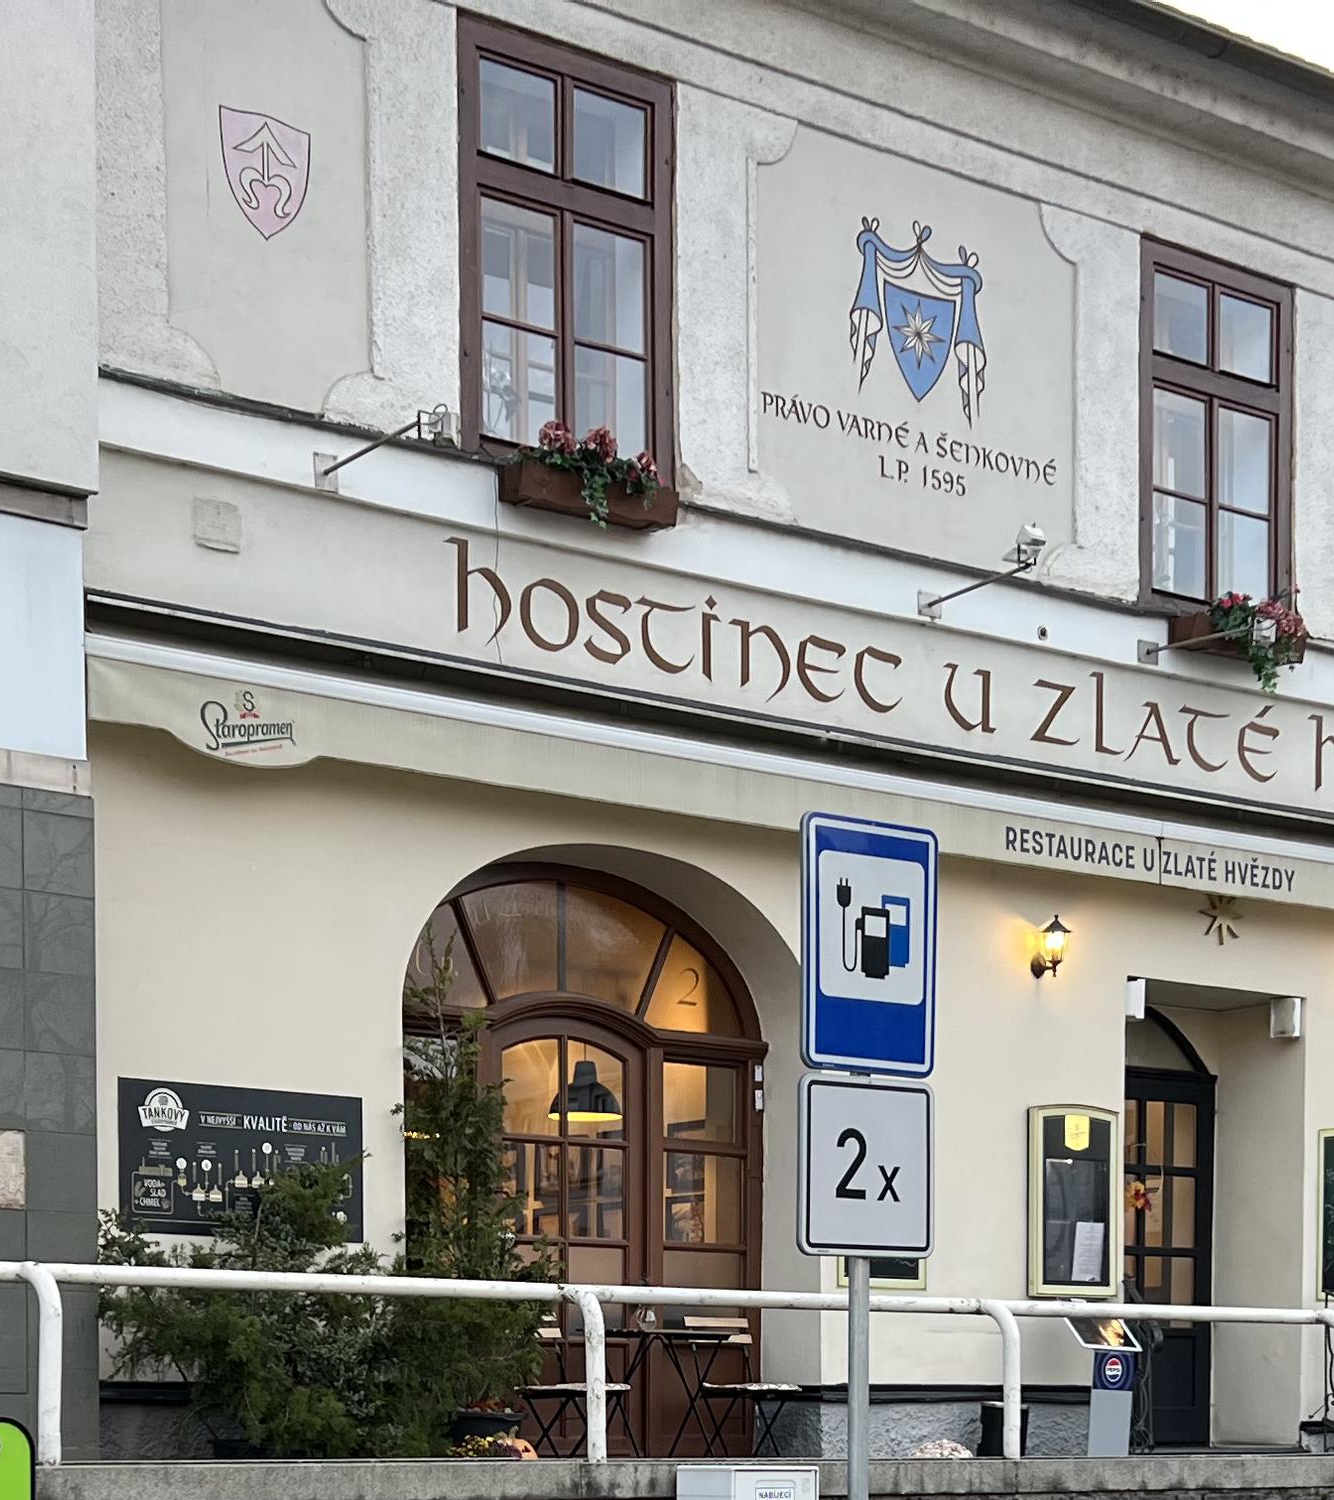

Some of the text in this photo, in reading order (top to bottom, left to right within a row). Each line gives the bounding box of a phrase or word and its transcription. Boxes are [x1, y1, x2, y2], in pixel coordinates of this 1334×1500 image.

[760, 391, 831, 430] PRÁVO
[837, 410, 910, 448] VARNÉ
[914, 432, 929, 454] A
[922, 465, 967, 497] 1595
[200, 700, 296, 750] Staropramen
[1030, 671, 1280, 784] ZLATÉ
[1005, 826, 1295, 892] RESTAURACE U ZLATÉ HVĚZDY
[677, 968, 700, 1006] 2
